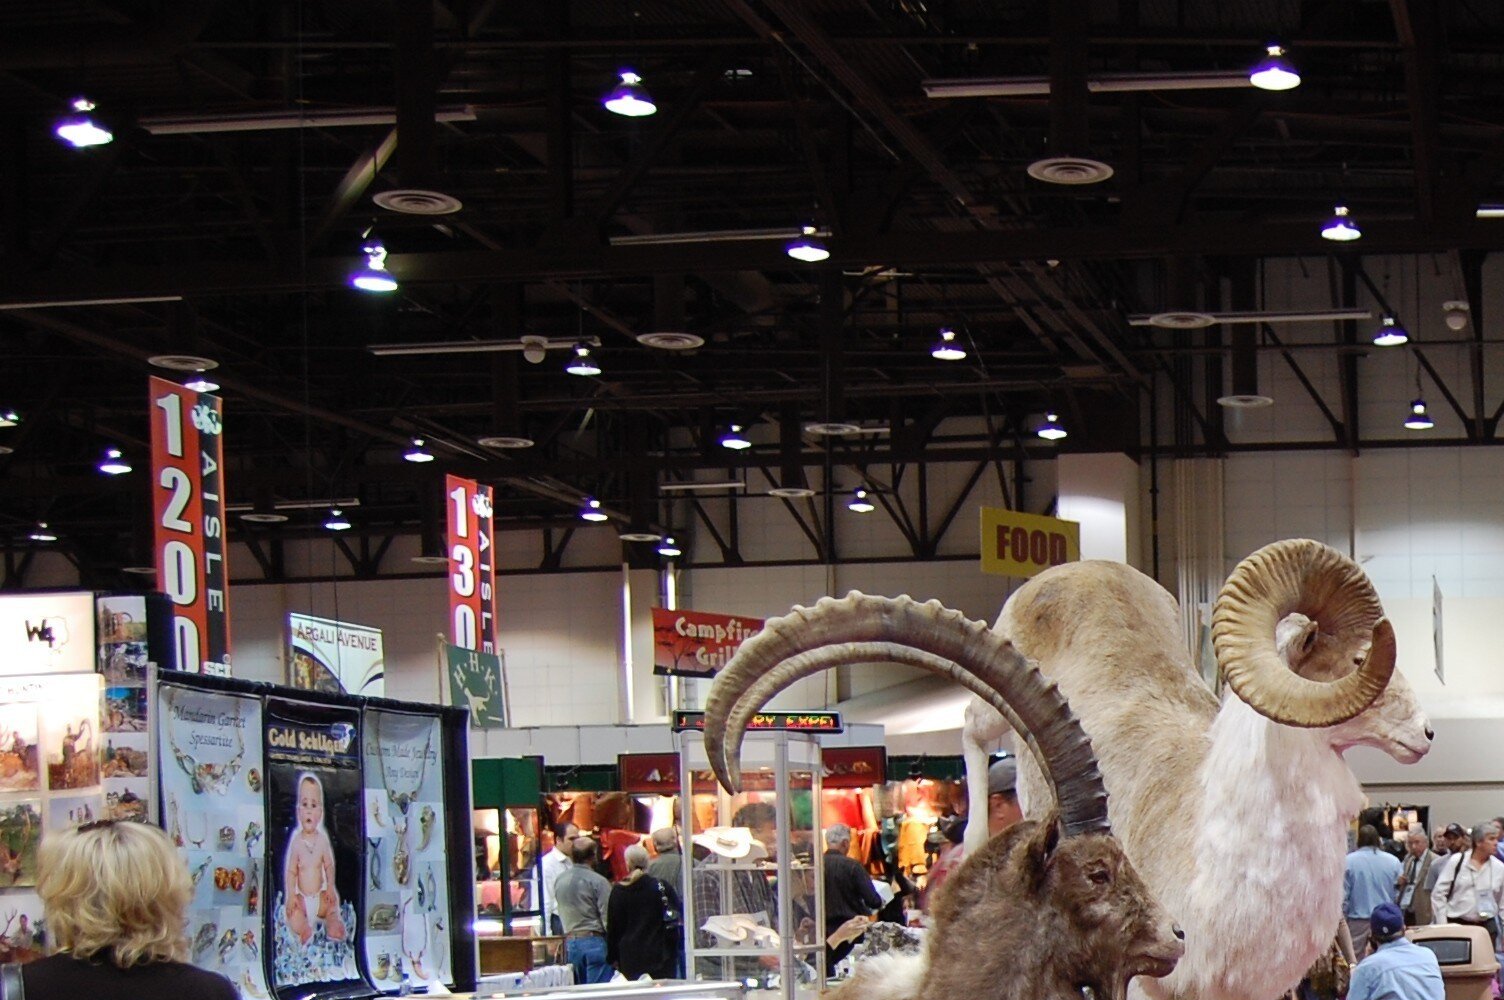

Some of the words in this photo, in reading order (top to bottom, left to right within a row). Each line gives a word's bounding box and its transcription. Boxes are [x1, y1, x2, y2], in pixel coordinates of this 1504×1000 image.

[156, 393, 200, 673] 1200
[201, 450, 224, 613] AISLE
[997, 525, 1067, 566] FOOD
[296, 621, 335, 644] ARGALI
[337, 629, 377, 651] AVENUE
[269, 727, 297, 748] Gold
